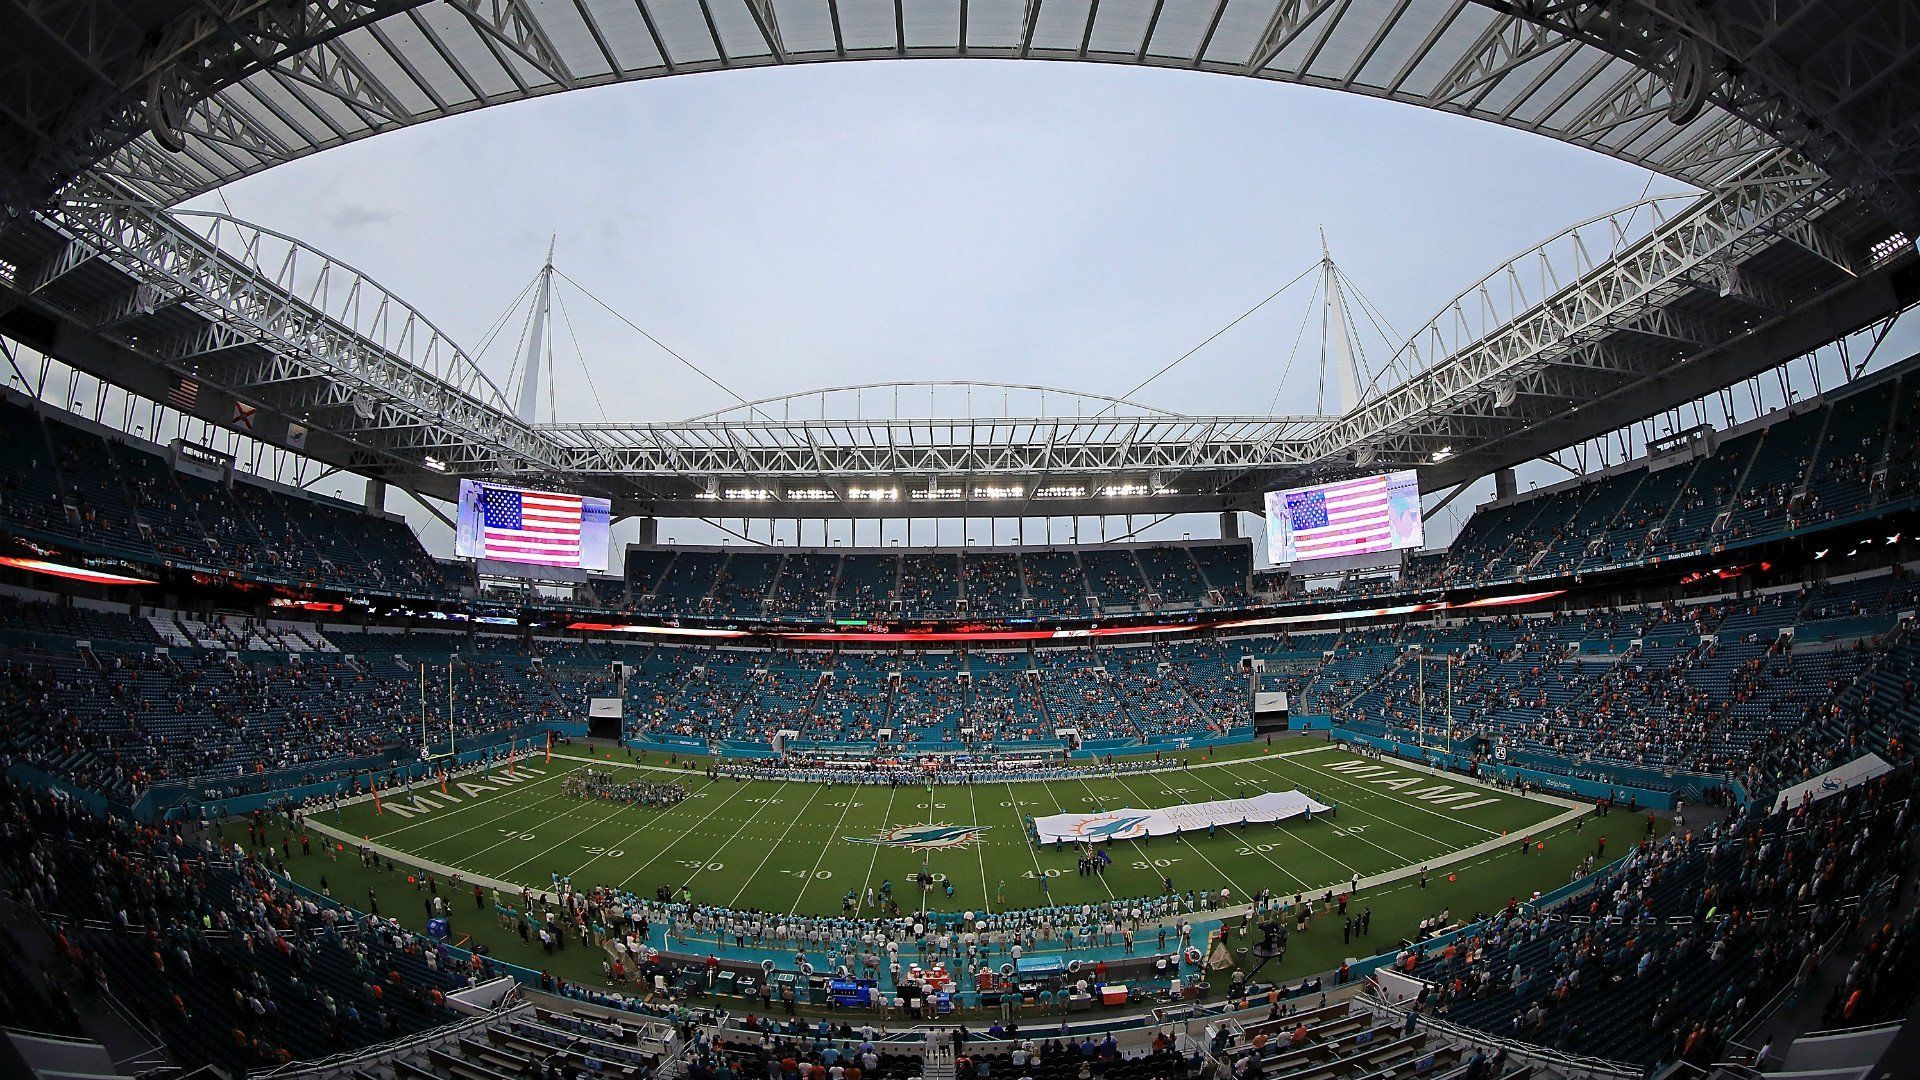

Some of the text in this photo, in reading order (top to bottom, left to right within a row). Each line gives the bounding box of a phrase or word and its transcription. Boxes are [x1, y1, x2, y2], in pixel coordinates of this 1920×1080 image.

[1322, 760, 1501, 810] MIAMI
[381, 765, 547, 818] MIAMI
[504, 831, 536, 841] 10
[1332, 825, 1364, 838] 10
[586, 847, 625, 858] 20
[1235, 844, 1275, 857] 20
[684, 860, 724, 871] 30
[1132, 858, 1171, 870] 30
[792, 870, 833, 880] 40
[1021, 868, 1061, 879] 40
